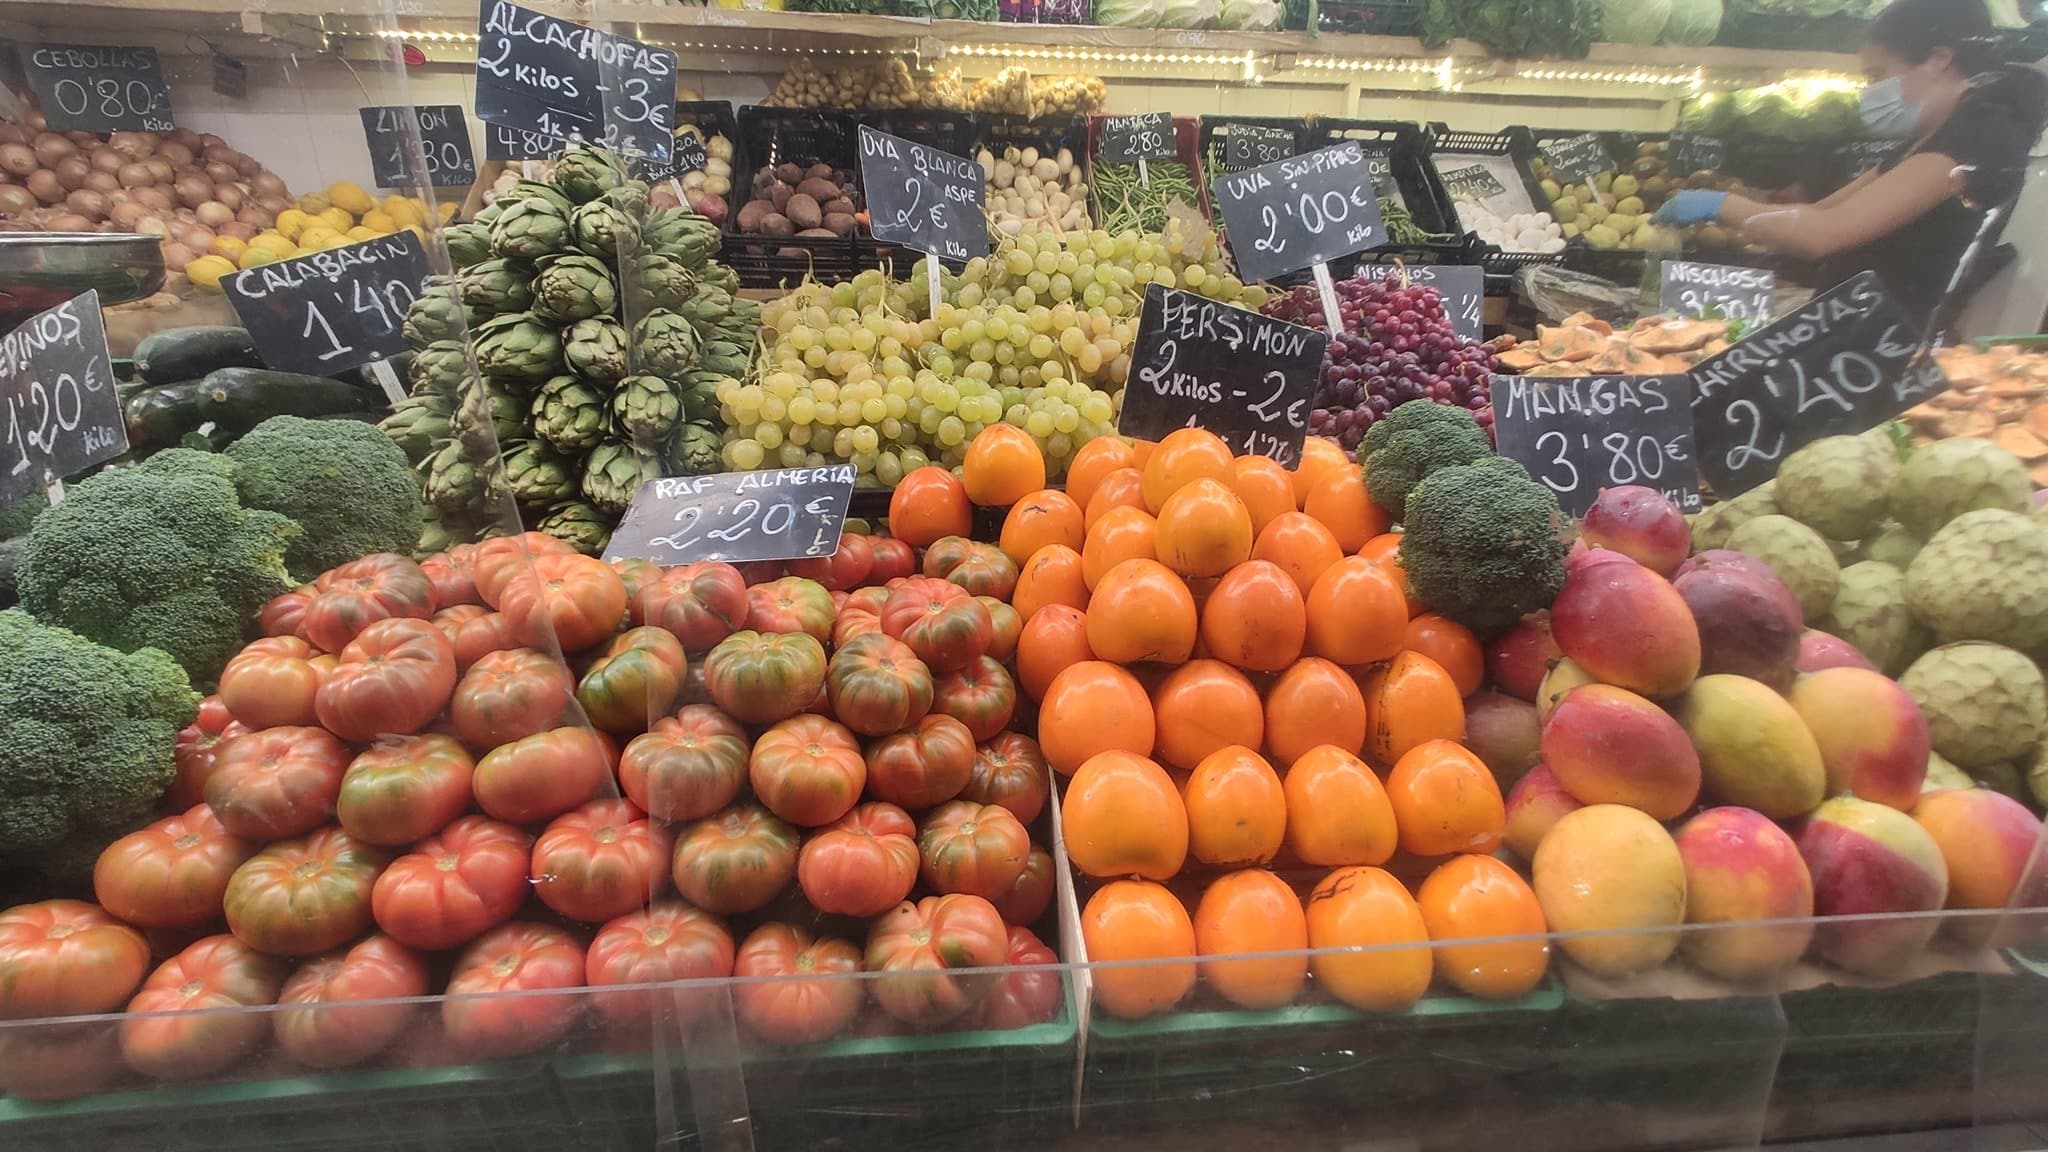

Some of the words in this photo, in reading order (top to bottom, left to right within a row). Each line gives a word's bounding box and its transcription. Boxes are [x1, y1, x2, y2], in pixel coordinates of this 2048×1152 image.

[485, 2, 669, 75] ALCACHOFAS
[33, 49, 152, 70] CEBOLLAS
[862, 129, 900, 160] UVA
[911, 146, 976, 182] BLANCA
[944, 184, 976, 206] ASPE
[1227, 173, 1271, 199] UVA
[655, 477, 715, 499] RAF
